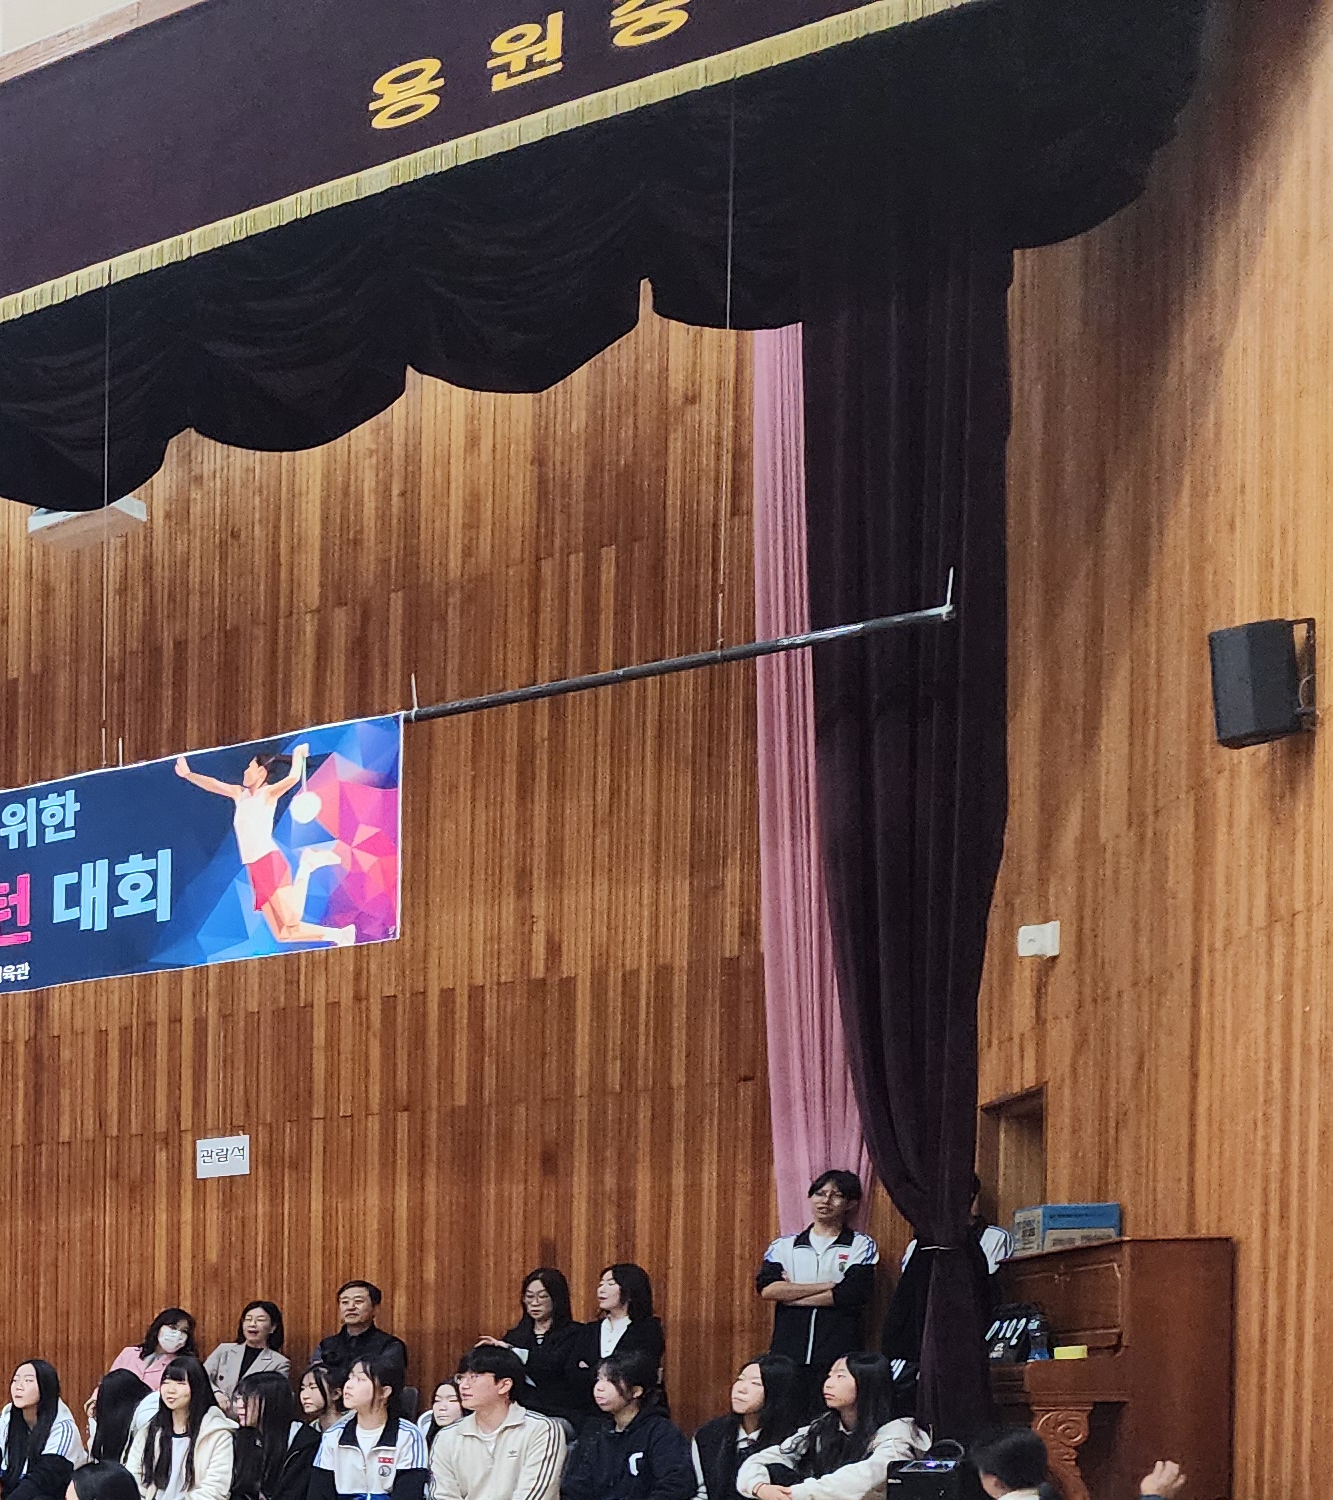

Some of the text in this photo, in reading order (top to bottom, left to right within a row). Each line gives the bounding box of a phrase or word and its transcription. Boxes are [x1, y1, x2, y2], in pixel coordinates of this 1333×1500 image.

[0, 789, 81, 850] 위한
[53, 848, 172, 932] 대회
[200, 1145, 246, 1164] 관람석
